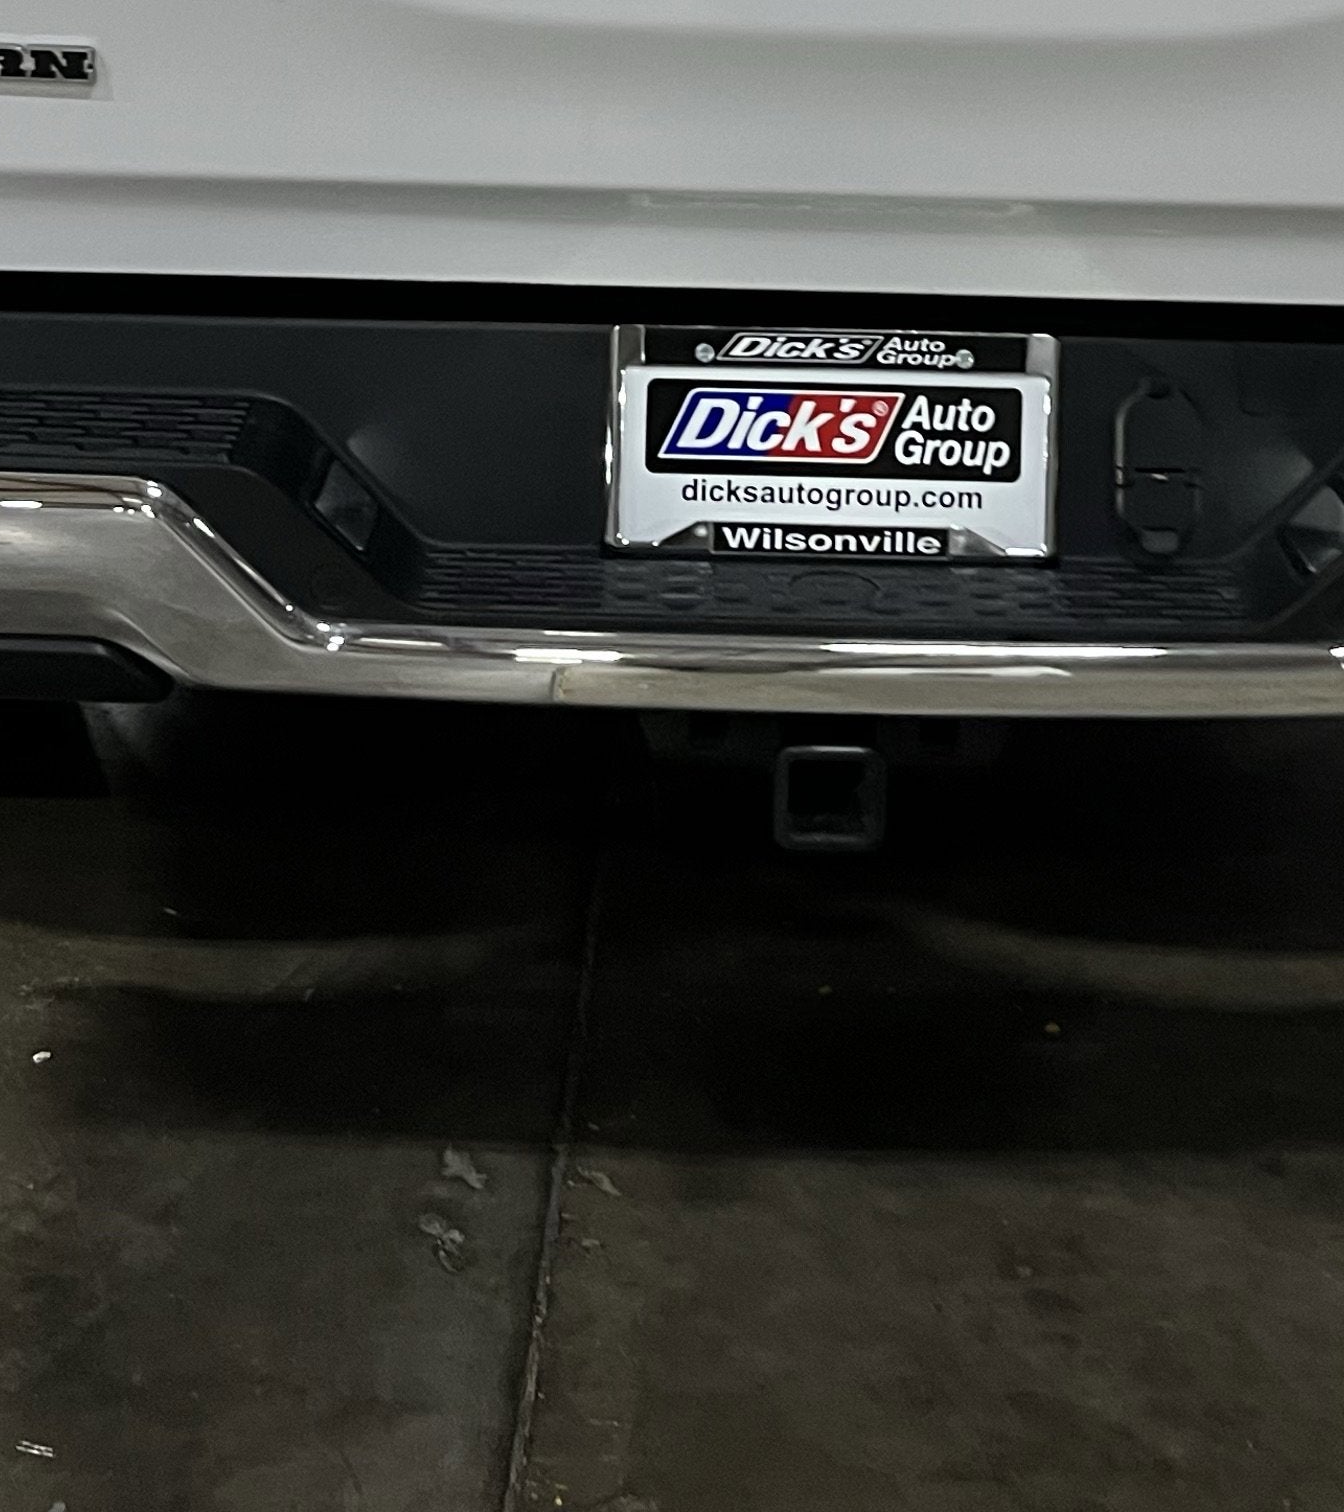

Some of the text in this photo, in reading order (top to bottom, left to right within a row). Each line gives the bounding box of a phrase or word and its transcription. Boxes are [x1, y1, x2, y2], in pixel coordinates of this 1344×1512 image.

[729, 336, 945, 360] Dick's Auto
[877, 350, 956, 369] Group
[676, 396, 996, 454] Dick's Auto
[894, 431, 1011, 475] Group
[682, 480, 983, 512] dicksautogroup.com
[721, 527, 942, 555] Wilsonville
